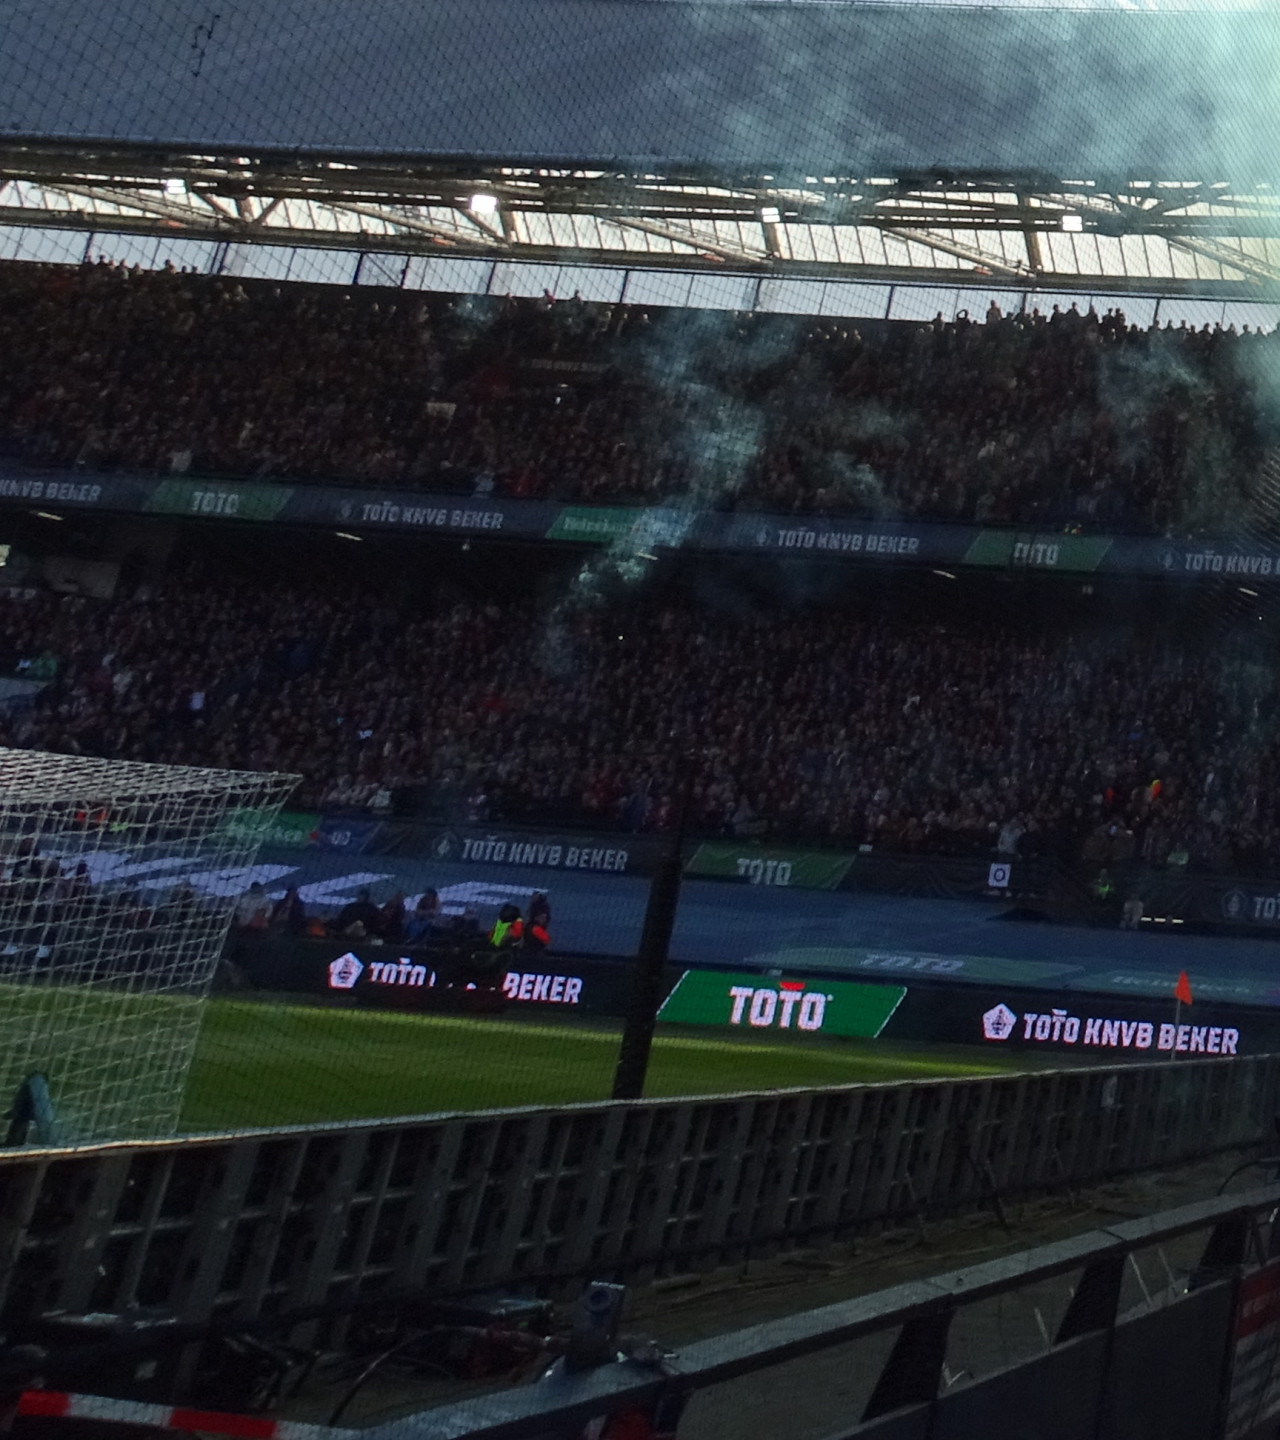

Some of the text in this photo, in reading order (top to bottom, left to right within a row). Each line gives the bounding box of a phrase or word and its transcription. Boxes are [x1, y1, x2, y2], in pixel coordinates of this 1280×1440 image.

[46, 482, 102, 502] BEKER
[192, 491, 240, 516] TOTO
[362, 500, 504, 530] TOTO KNVB BEKER
[777, 526, 920, 556] TOTO KNVB BEKER
[1184, 549, 1224, 574] TOTO
[1226, 554, 1271, 576] KNVB
[462, 835, 630, 872] TOTO KNVB BEKER
[737, 857, 793, 886] TOTO
[502, 971, 583, 1004] BEKER
[729, 980, 831, 1033] TOTO
[1023, 1008, 1240, 1058] TOTO KNVB BEKER
